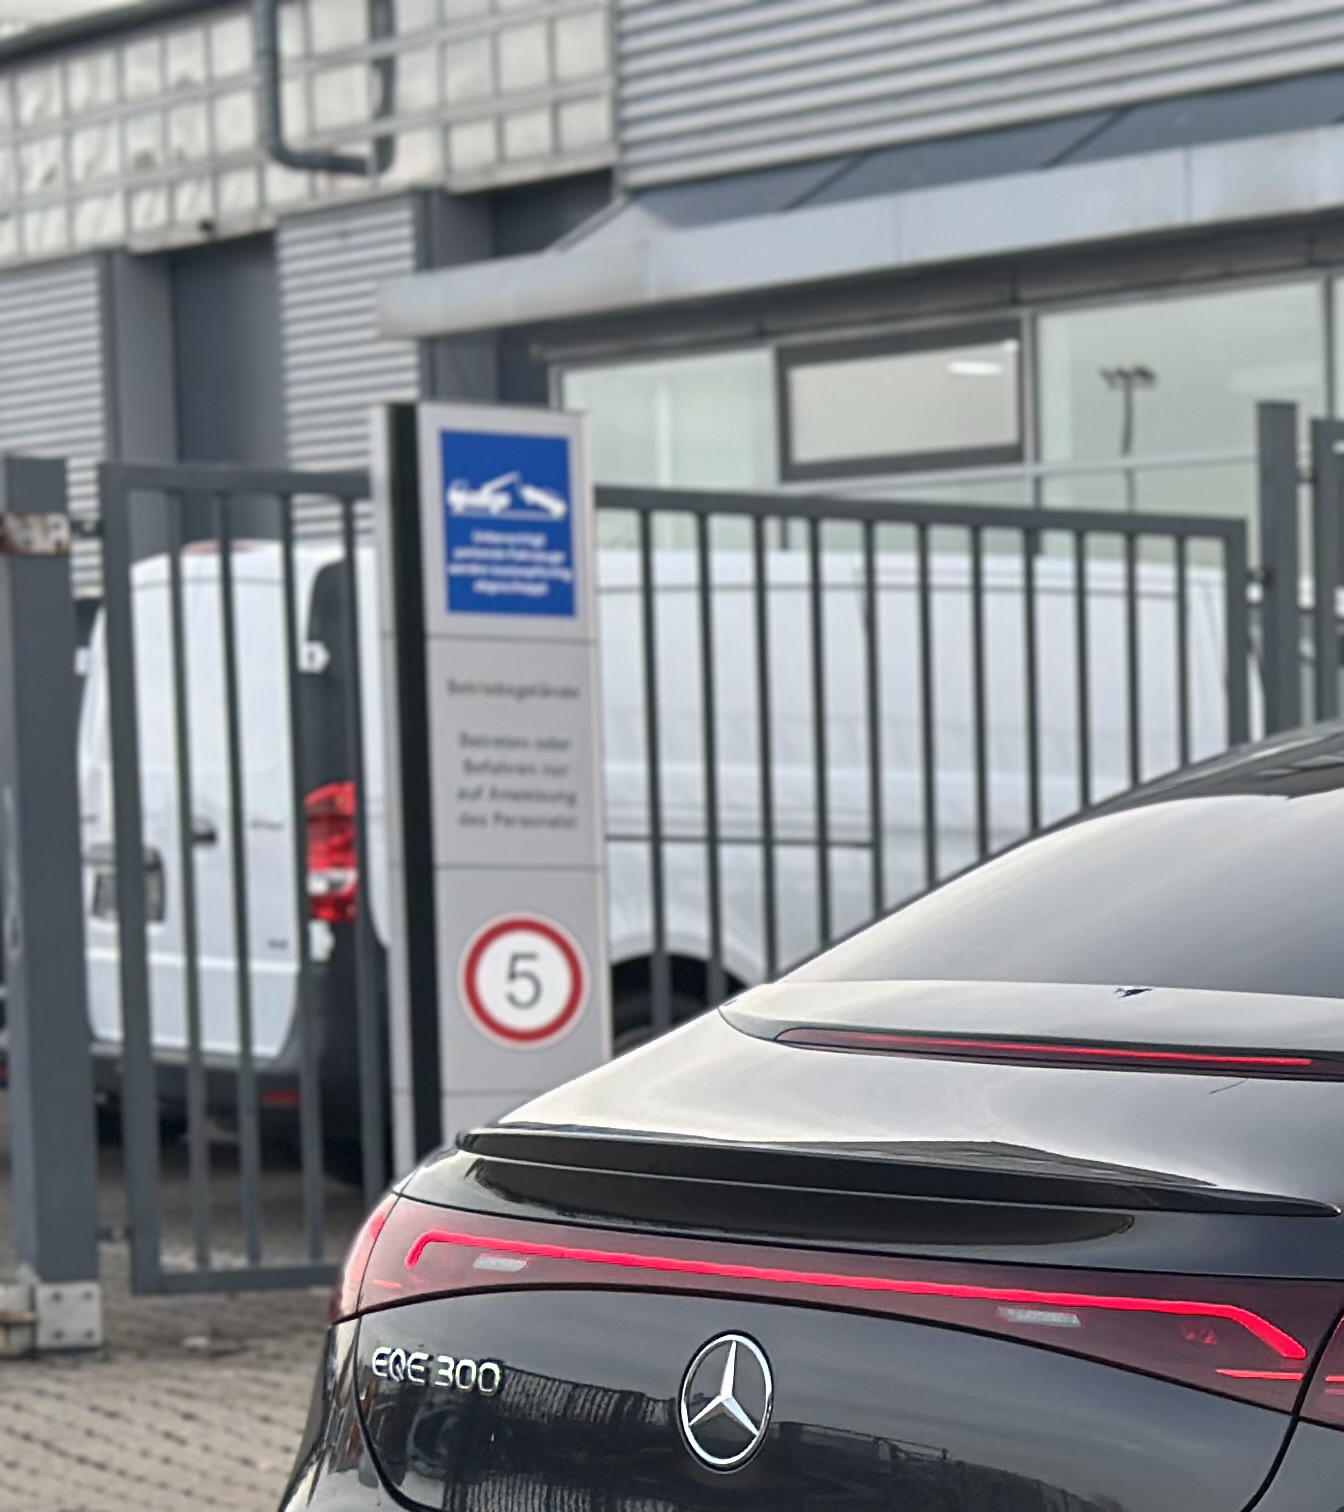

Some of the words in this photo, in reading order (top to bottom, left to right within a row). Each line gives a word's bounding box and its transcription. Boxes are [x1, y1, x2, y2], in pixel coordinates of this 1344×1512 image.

[506, 953, 542, 1010] 5
[372, 1347, 429, 1384] EQE
[434, 1355, 500, 1394] 300
